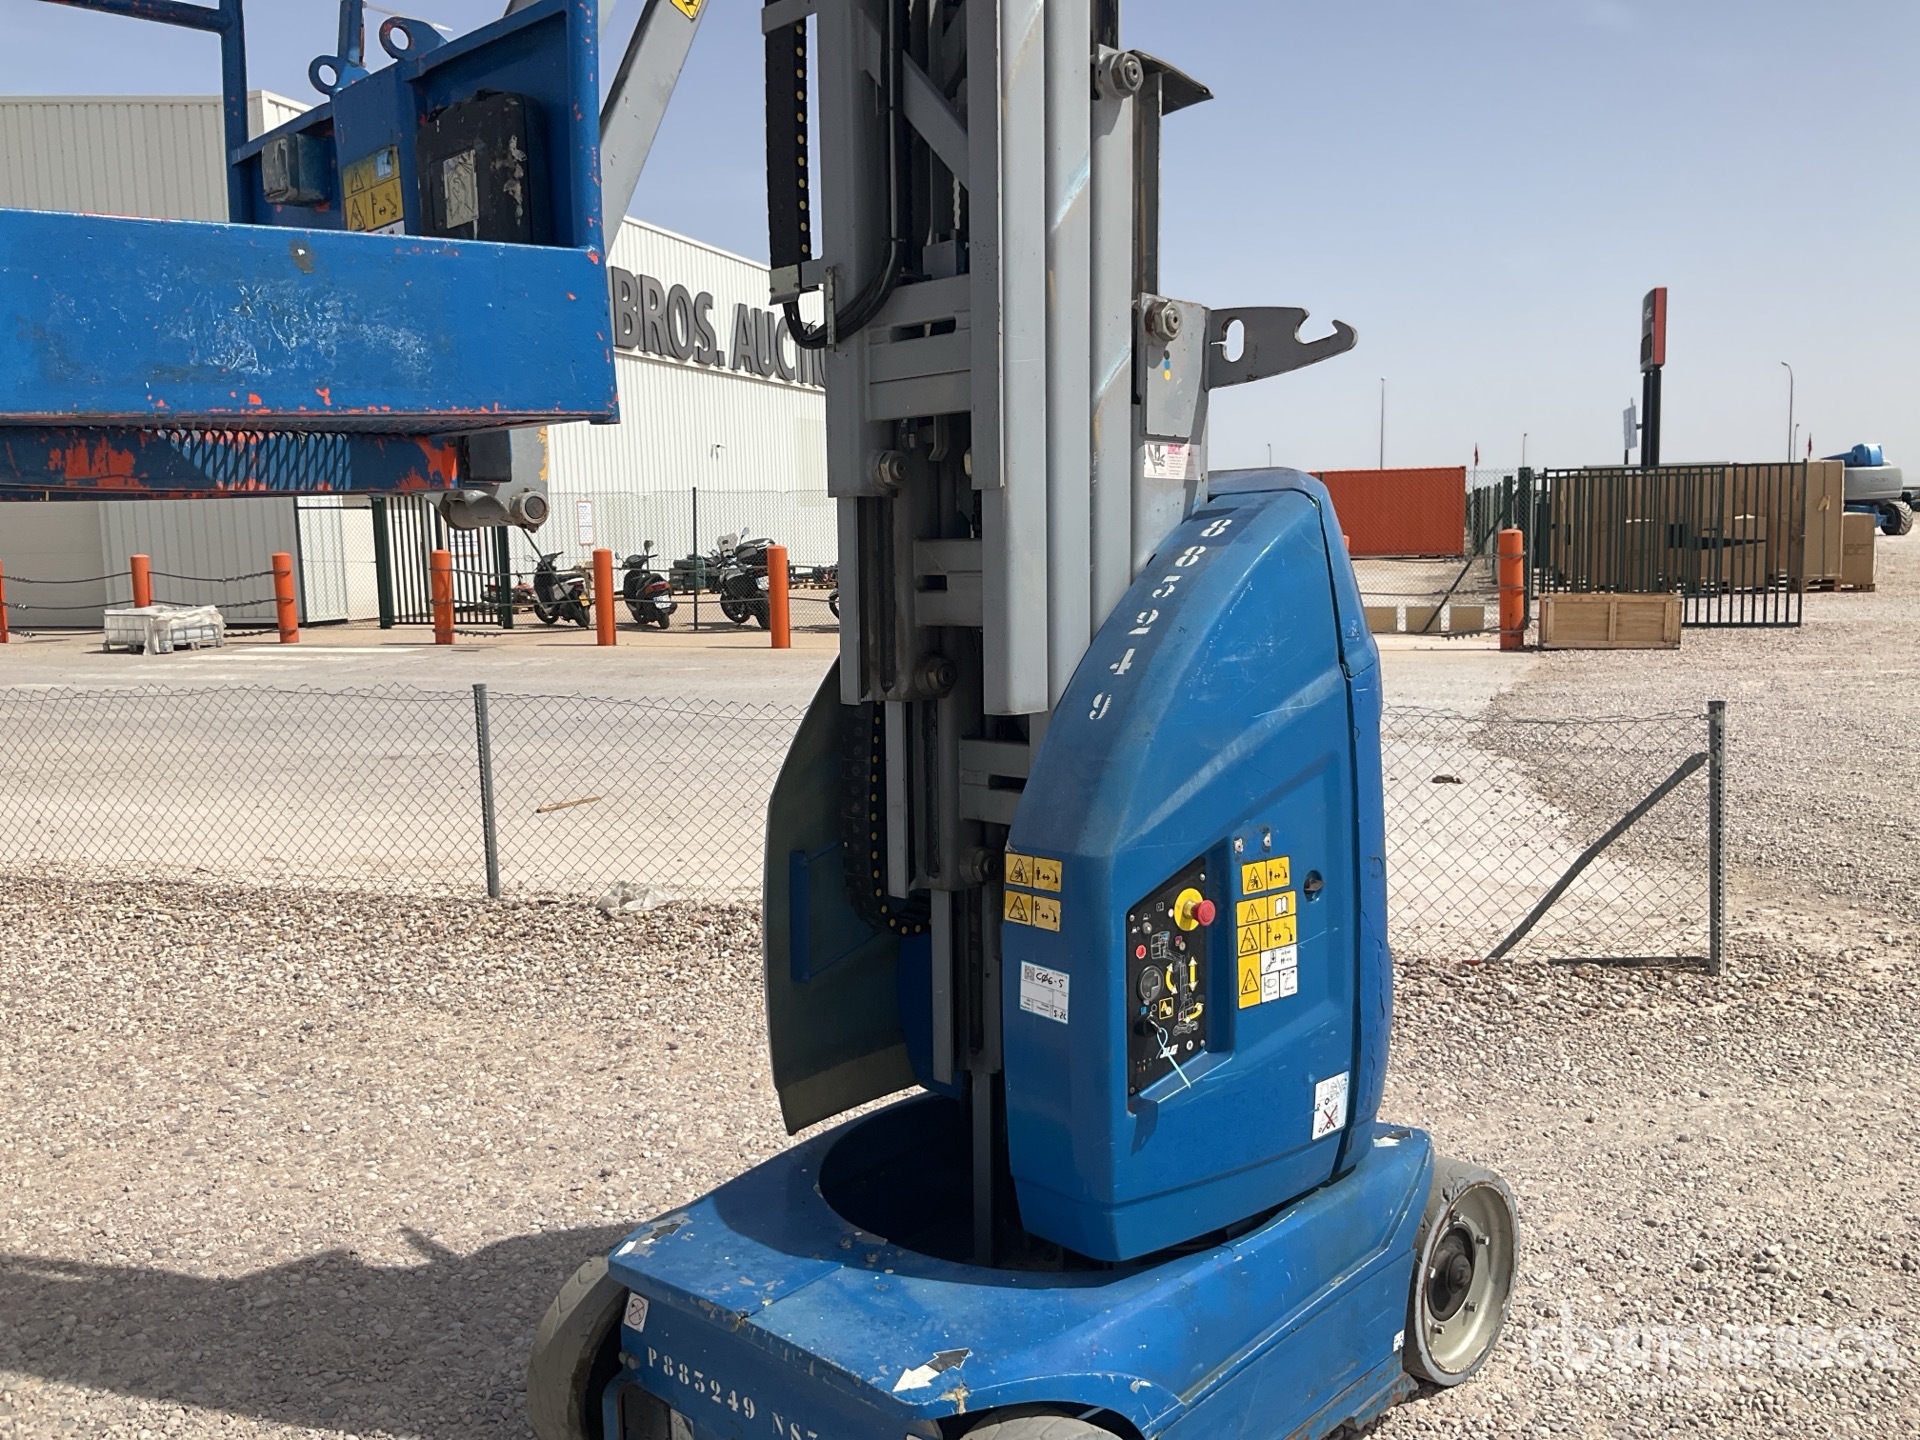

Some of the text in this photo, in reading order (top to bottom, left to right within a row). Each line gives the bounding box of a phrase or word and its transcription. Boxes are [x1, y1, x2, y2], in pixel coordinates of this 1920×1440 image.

[608, 266, 825, 388] BROS. AUCTI
[647, 1346, 756, 1420] P883249
